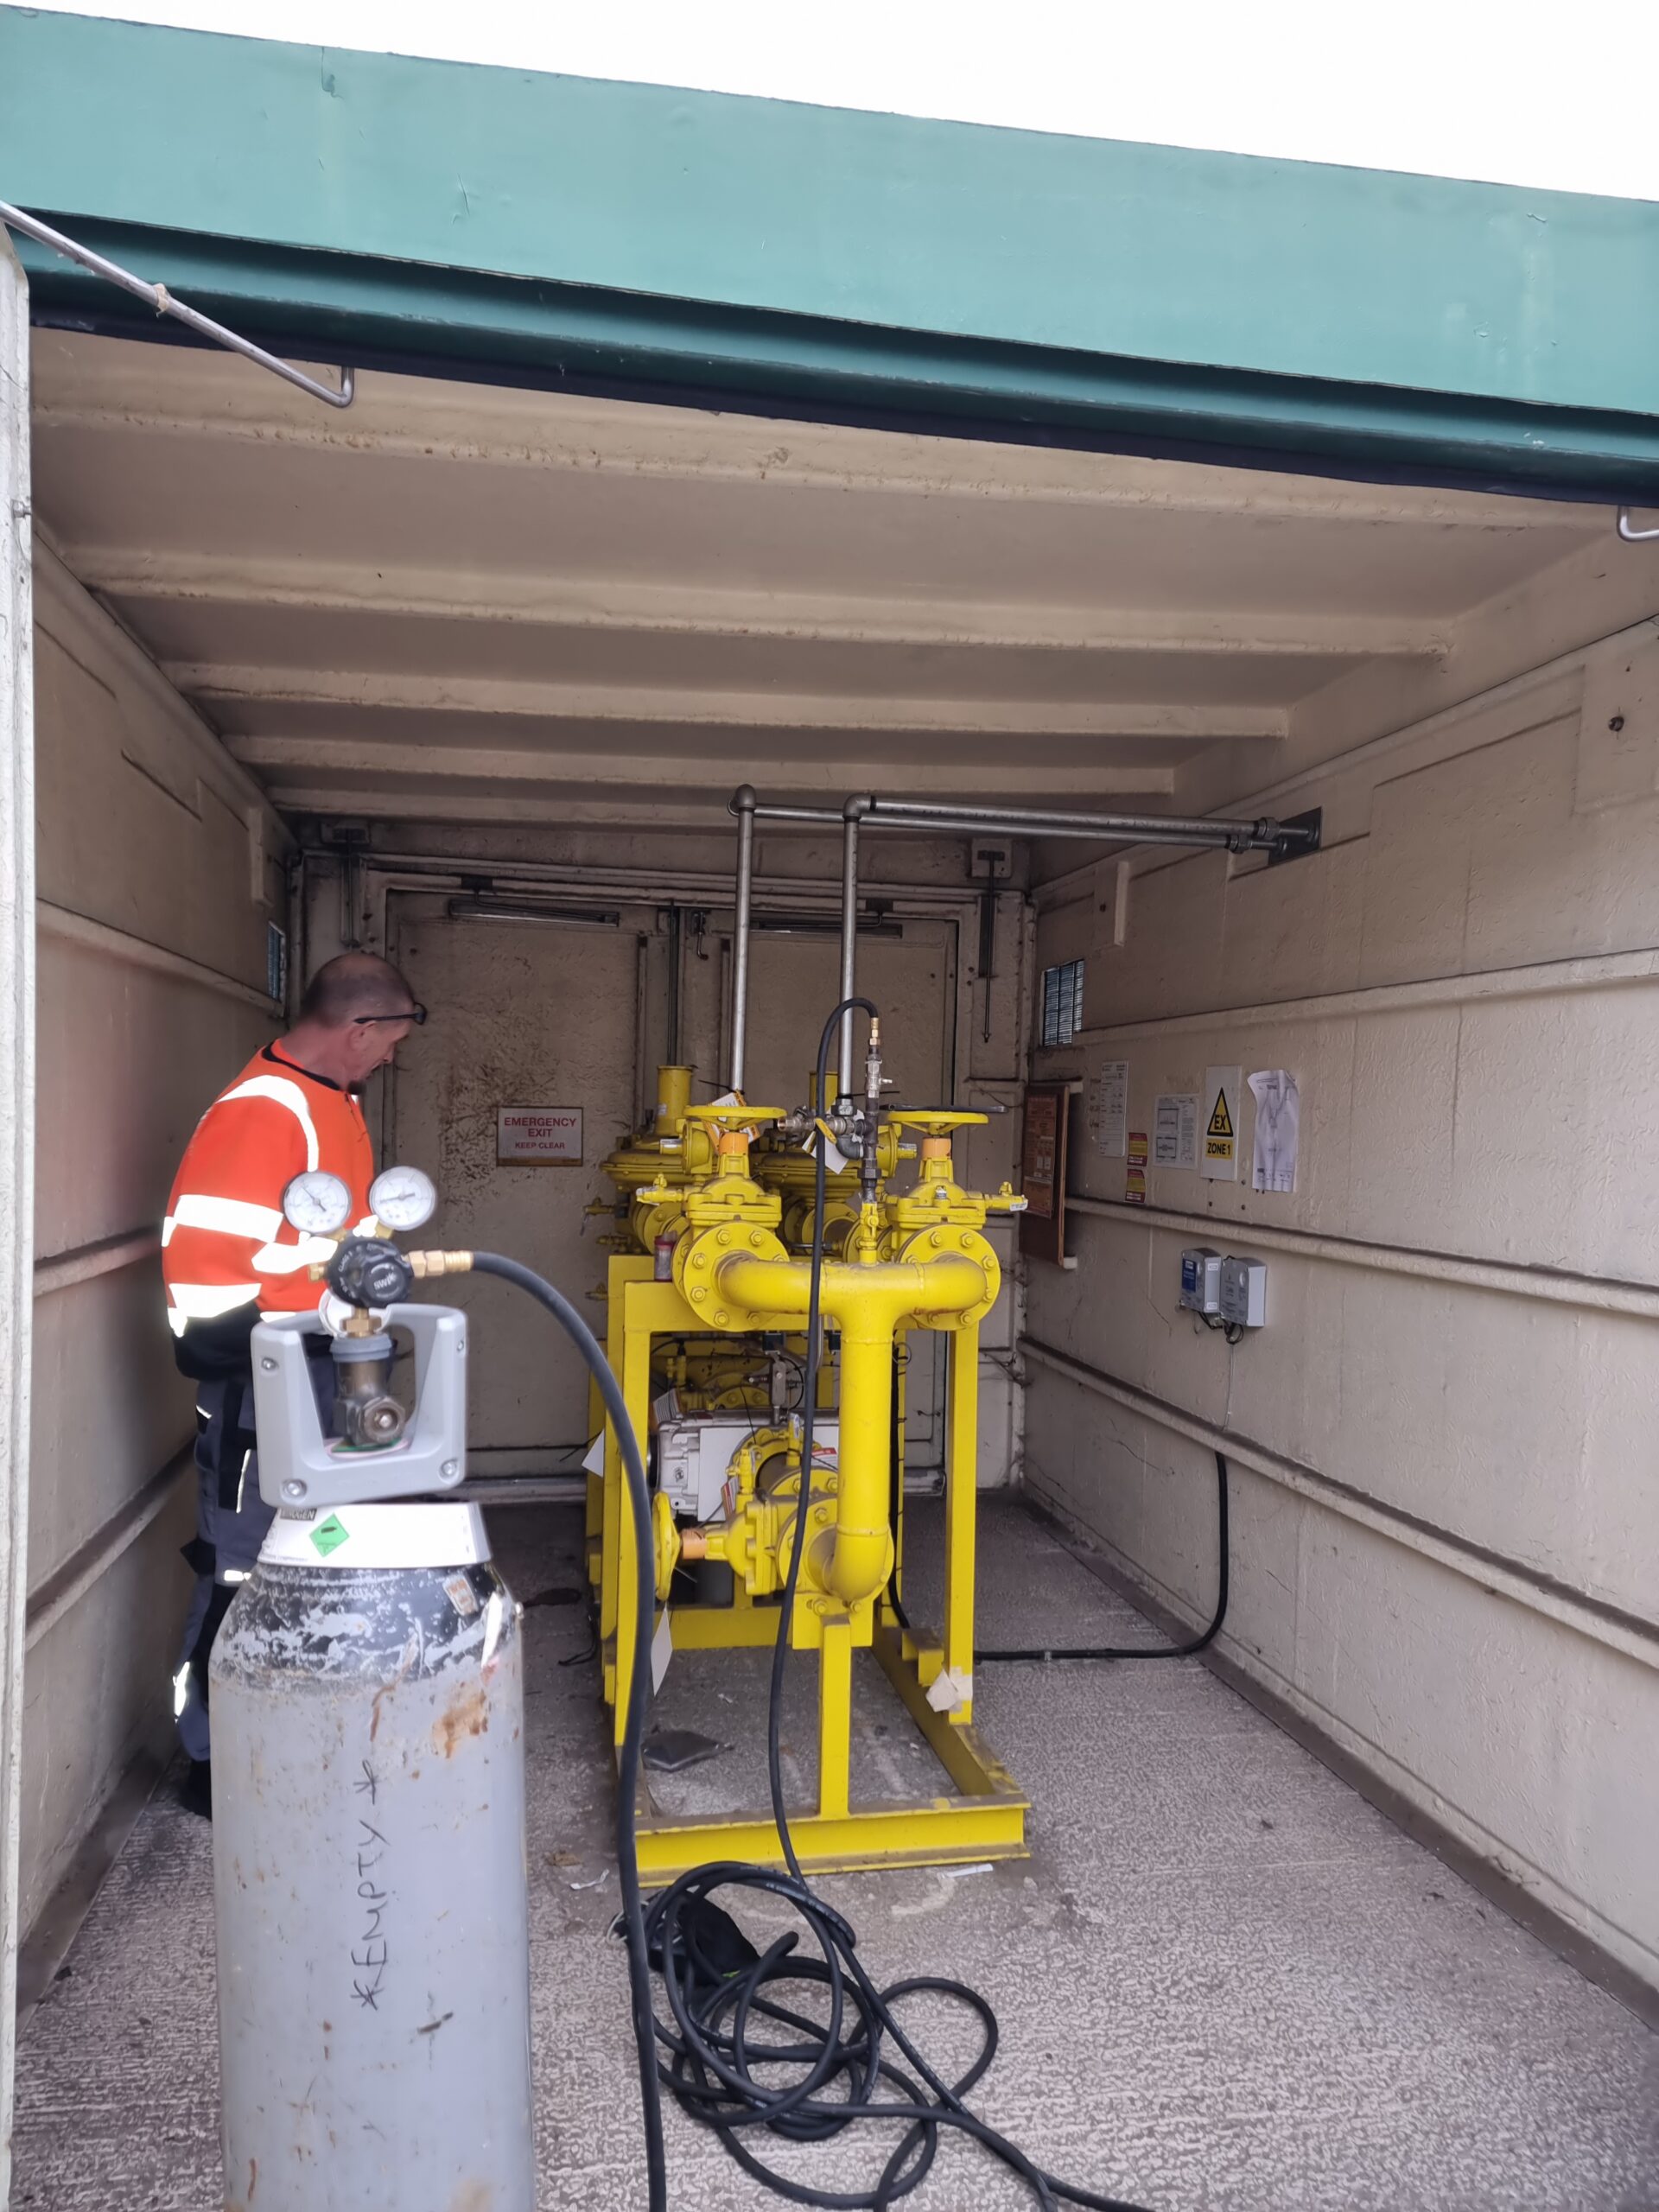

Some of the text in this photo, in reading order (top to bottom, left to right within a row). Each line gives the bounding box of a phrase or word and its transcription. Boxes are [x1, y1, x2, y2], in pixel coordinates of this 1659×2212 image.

[504, 1117, 576, 1127] EMERGENCY
[1214, 1115, 1226, 1130] EX
[528, 1128, 553, 1137] EXIT
[1207, 1141, 1230, 1154] ZONE 1
